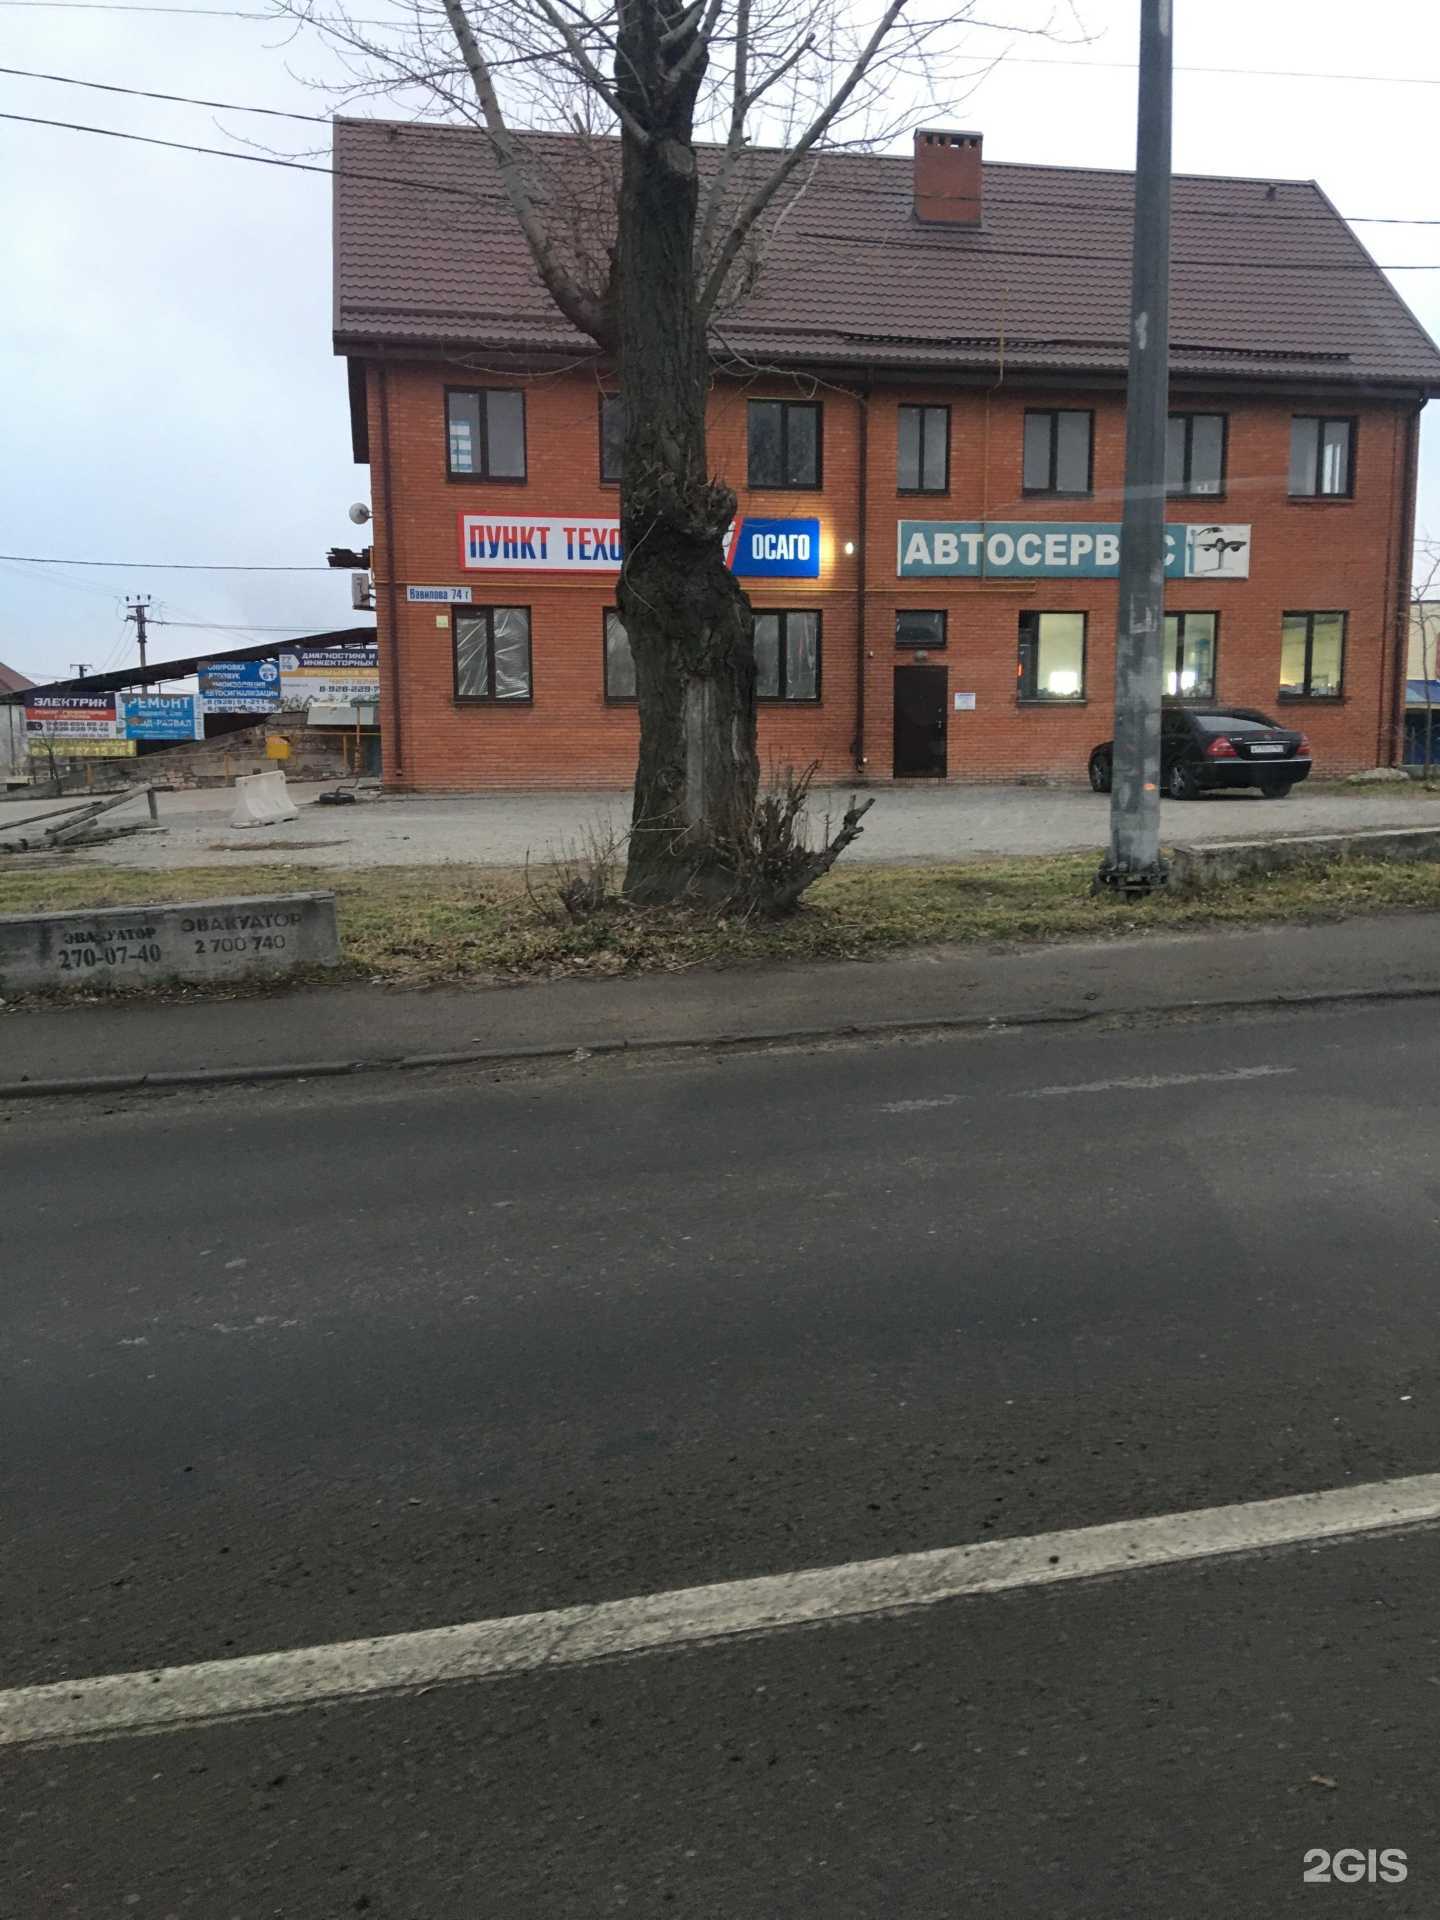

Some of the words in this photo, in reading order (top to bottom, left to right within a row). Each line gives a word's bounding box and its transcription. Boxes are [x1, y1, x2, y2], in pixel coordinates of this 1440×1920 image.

[468, 524, 551, 560] ПУНКТ
[563, 526, 624, 561] ТЕХО
[751, 533, 811, 561] ОСАГО
[903, 532, 1176, 567] АВТОСЕРВ
[410, 588, 448, 600] Вавилова
[451, 588, 462, 600] 74
[33, 697, 108, 707] ЭЛЕКТРИК
[129, 696, 190, 708] РЕМОНТ
[181, 913, 301, 932] ЭВАКУАТОР
[251, 934, 286, 950] 740
[58, 944, 161, 971] 270-07-40
